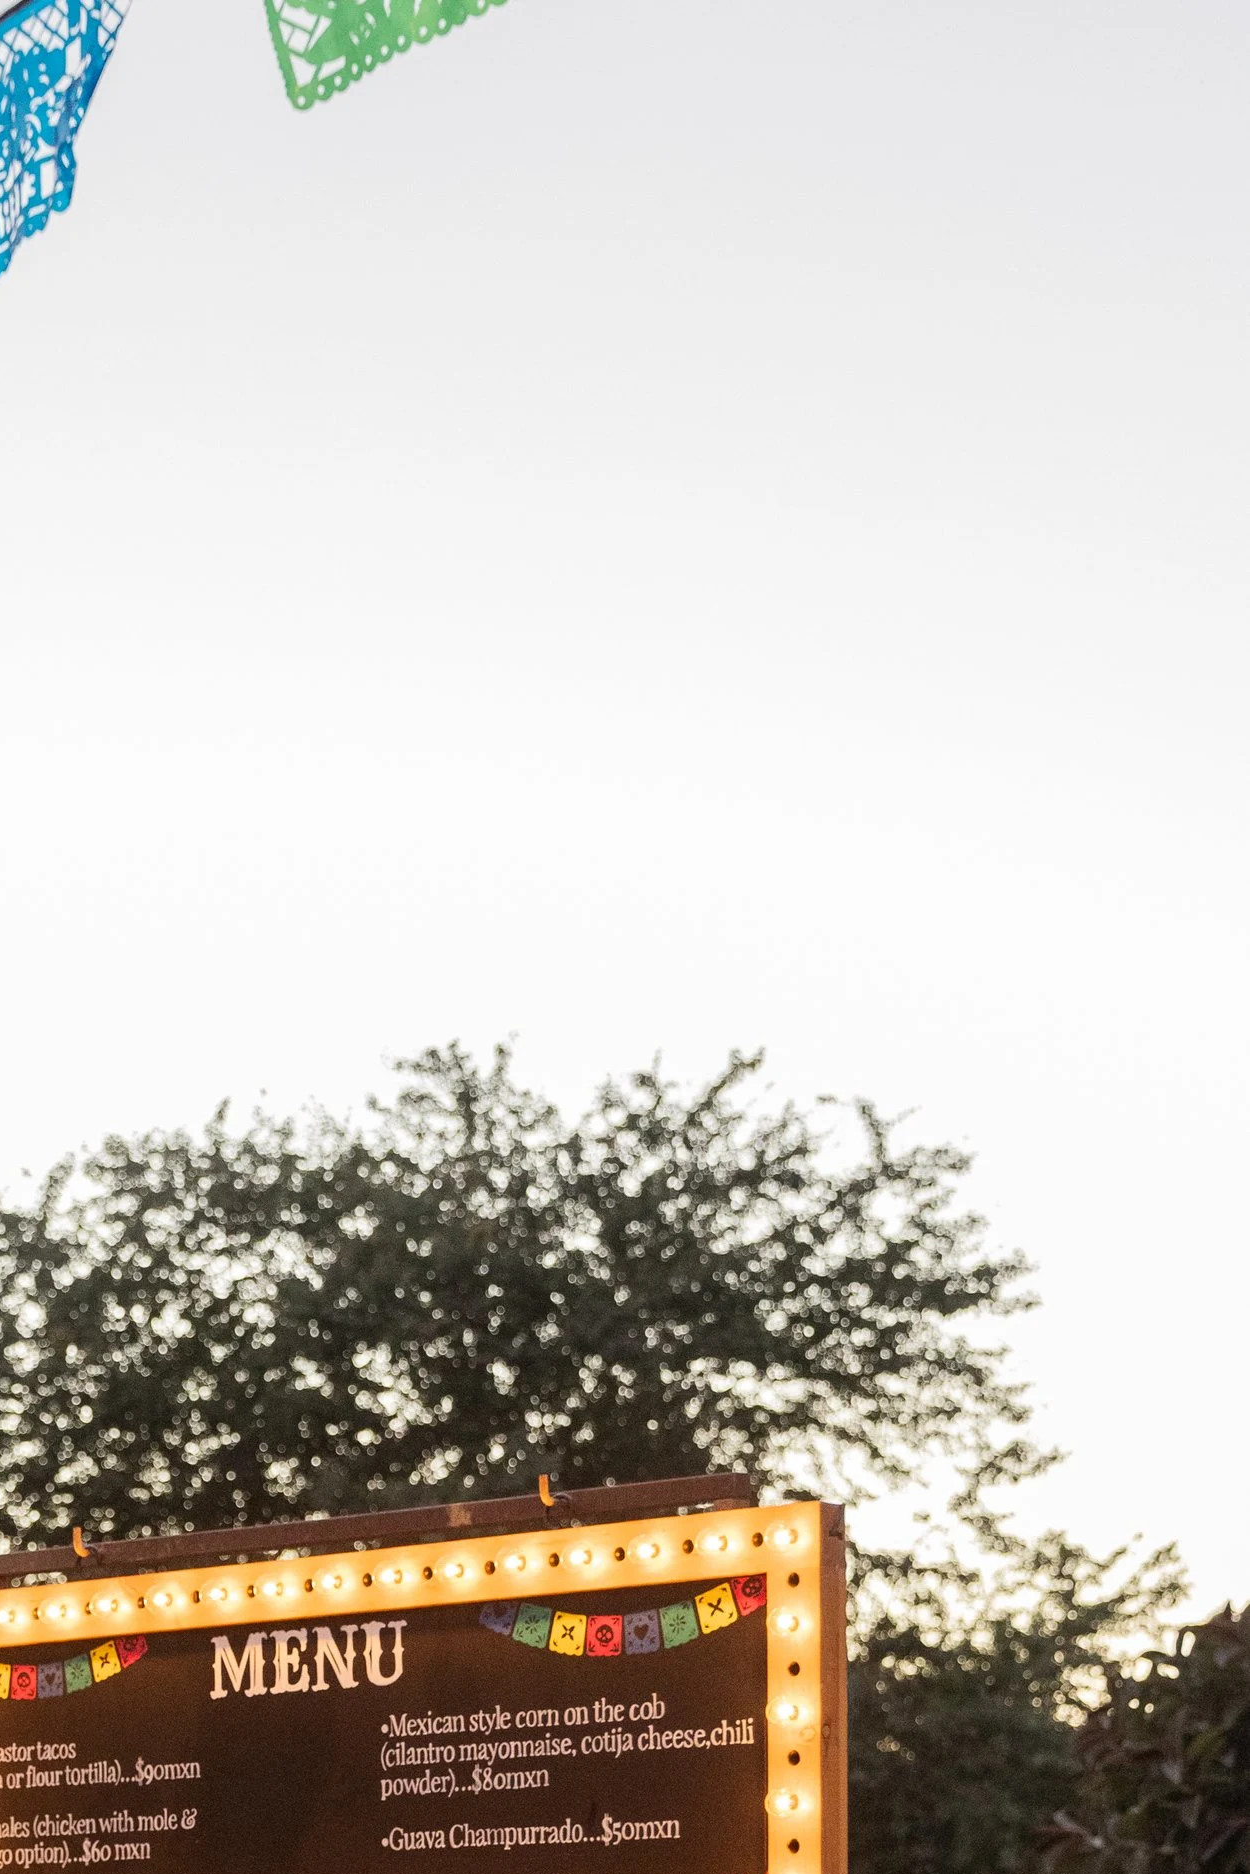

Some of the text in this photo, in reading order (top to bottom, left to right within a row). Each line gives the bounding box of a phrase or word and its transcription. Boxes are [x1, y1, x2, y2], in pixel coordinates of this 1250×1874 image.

[209, 1619, 407, 1700] MENU
[469, 1705, 511, 1735] style
[515, 1708, 560, 1728] corn
[563, 1706, 590, 1726] on
[592, 1697, 625, 1724] the
[629, 1693, 666, 1721] cob
[36, 1741, 77, 1760] tacos
[380, 1741, 456, 1771] (cilantro
[458, 1733, 577, 1766] mayonnaise,
[581, 1726, 634, 1759] cotija
[6, 1771, 24, 1789] or
[26, 1765, 63, 1788] flour
[33, 1813, 96, 1838] (chicken
[99, 1810, 134, 1833] with
[137, 1808, 178, 1831] mole
[181, 1808, 197, 1829] &
[114, 1842, 151, 1861] mxn
